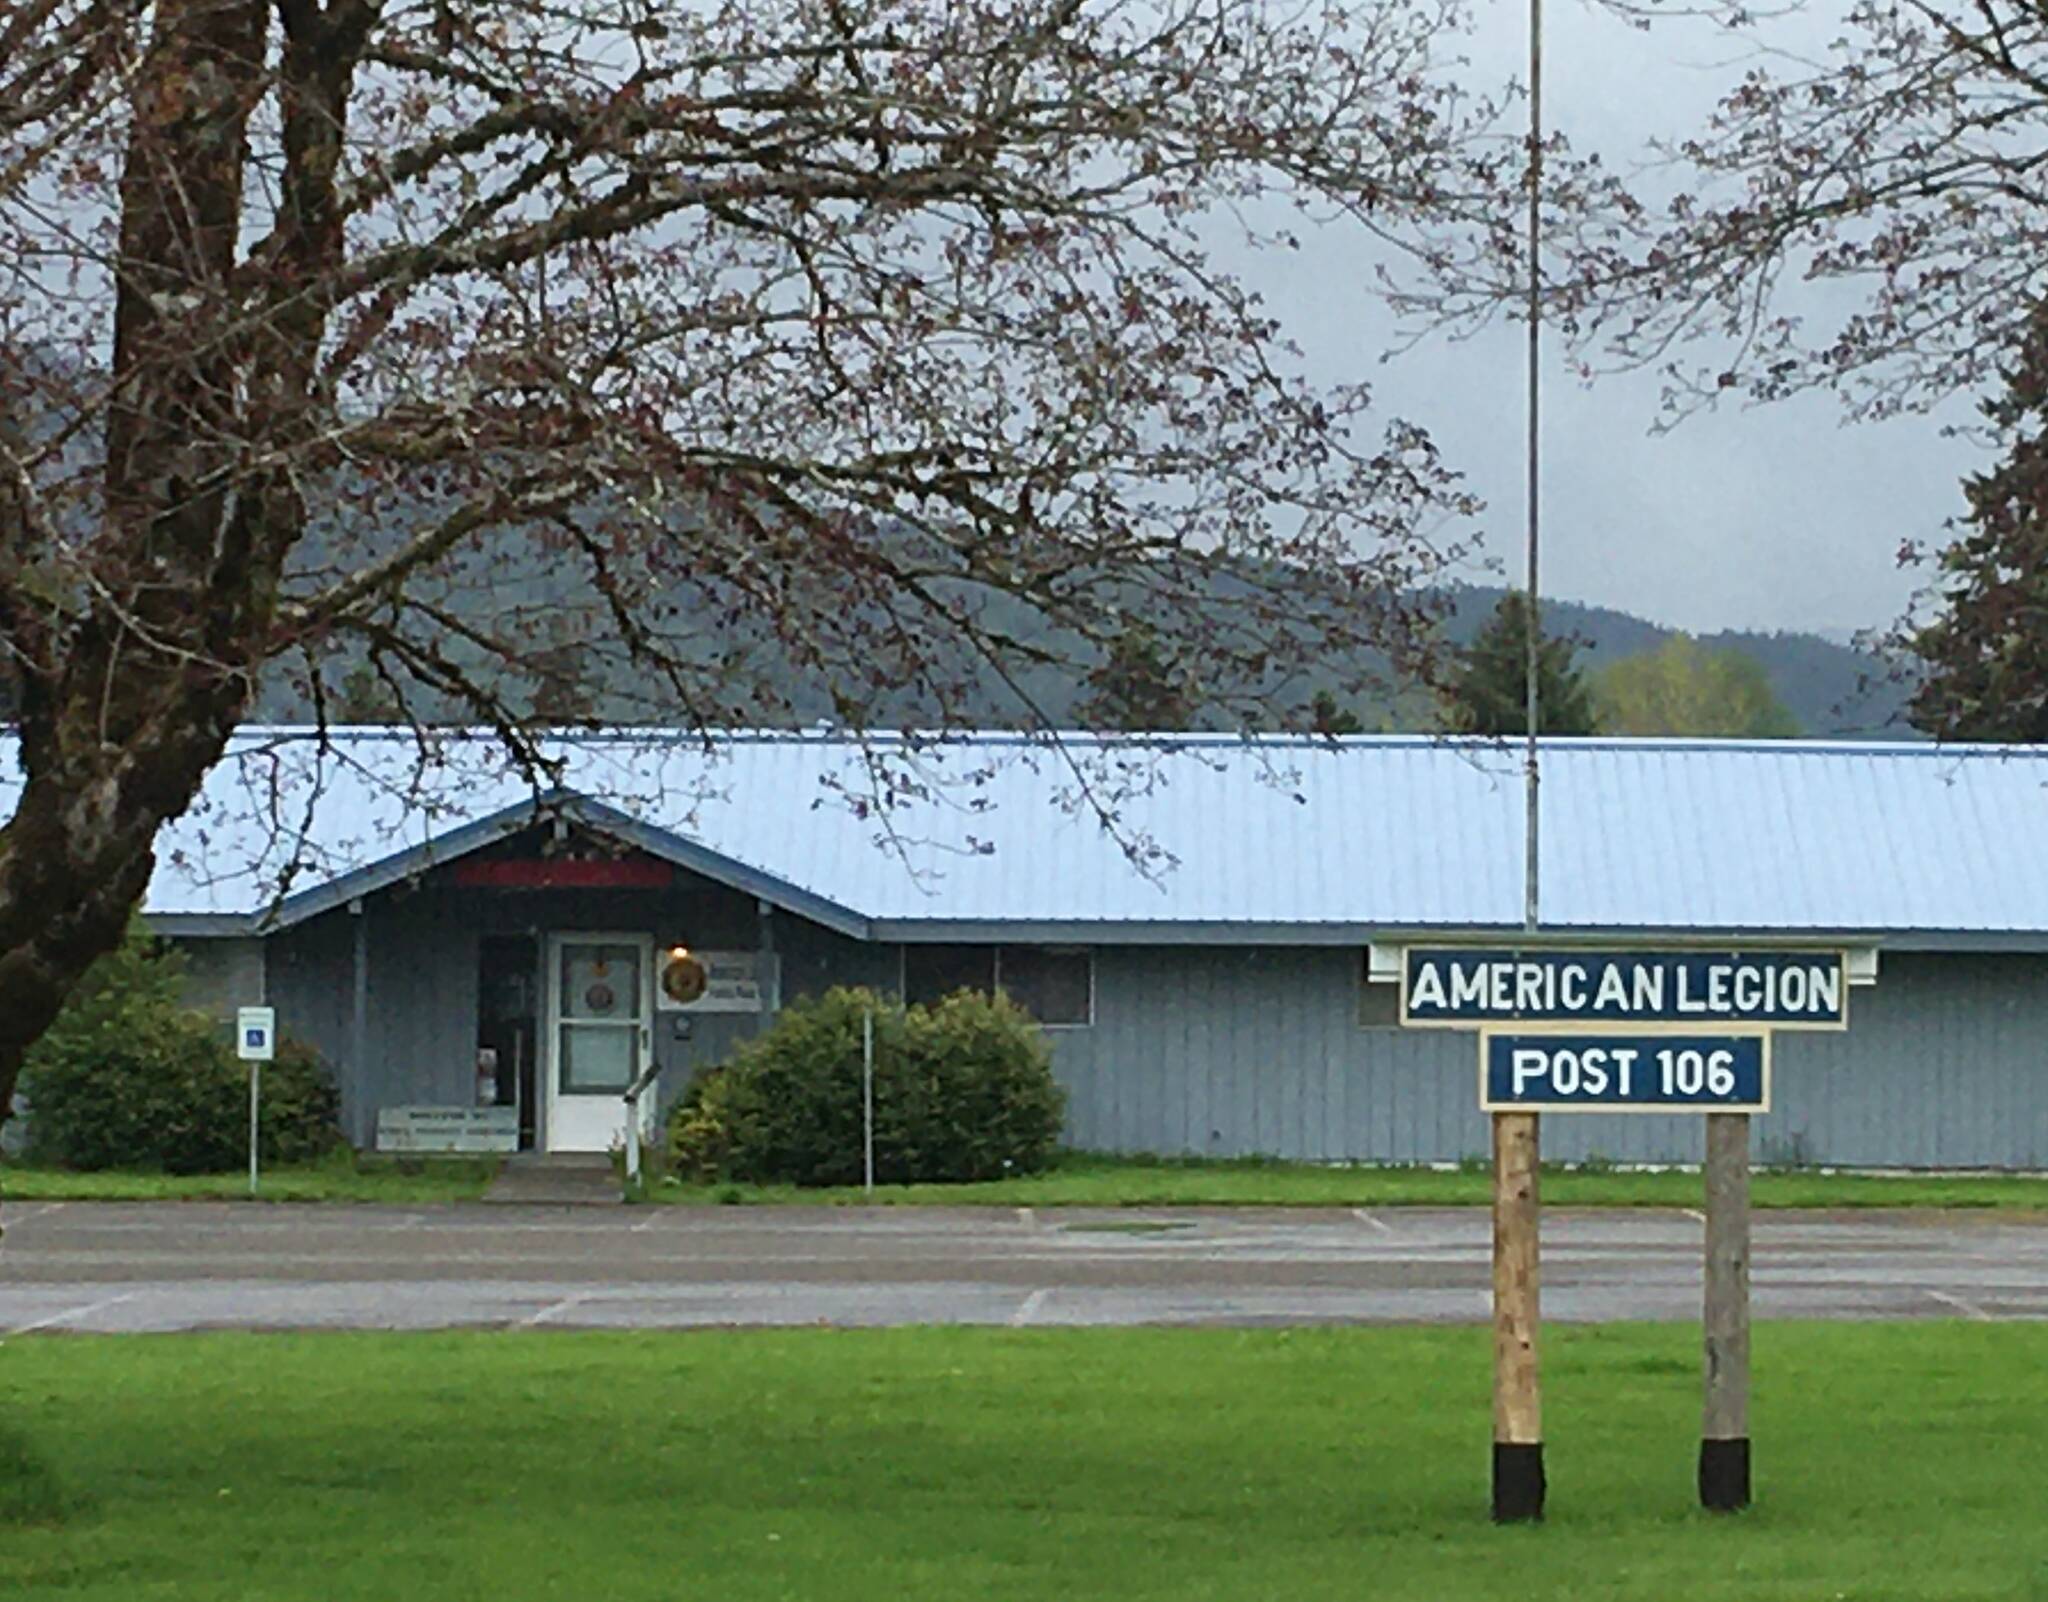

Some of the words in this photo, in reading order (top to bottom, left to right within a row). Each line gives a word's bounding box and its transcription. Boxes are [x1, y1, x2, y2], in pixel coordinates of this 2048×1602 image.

[1409, 961, 1664, 1012] AMERICAN
[1676, 964, 1840, 1014] LEGION
[1511, 1049, 1638, 1096] POST
[1656, 1050, 1736, 1097] 106
